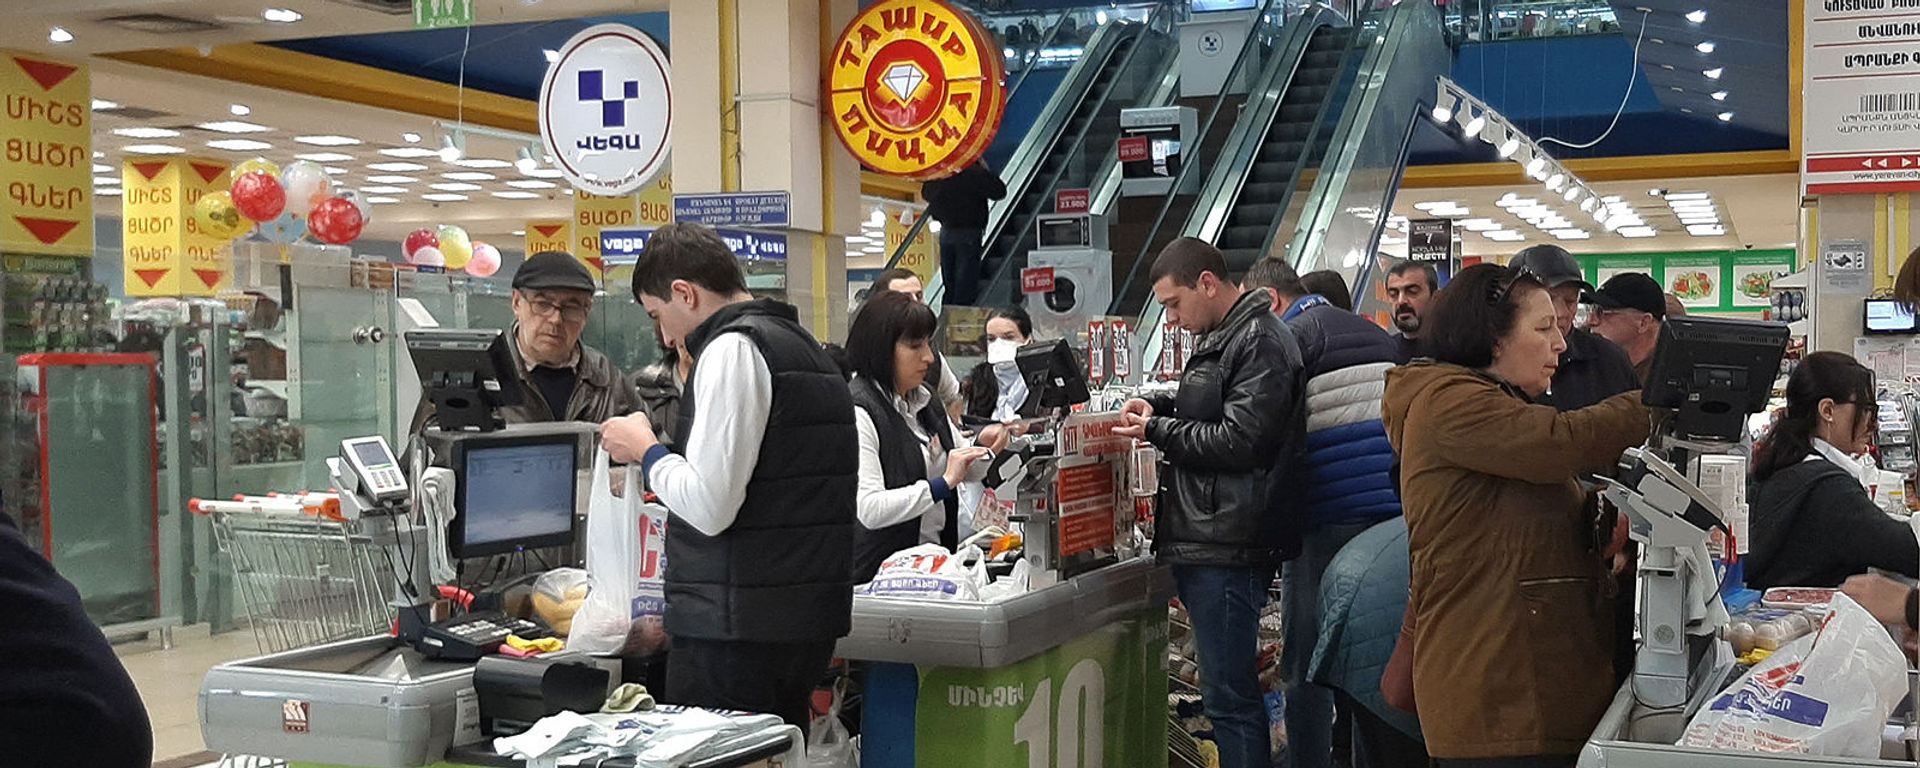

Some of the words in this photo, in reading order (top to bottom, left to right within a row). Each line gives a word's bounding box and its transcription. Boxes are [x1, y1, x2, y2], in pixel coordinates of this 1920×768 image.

[839, 6, 966, 68] ТАШИР
[1845, 53, 1909, 68] ԱՊՐԱՆՔԻ
[6, 94, 83, 127] ՄԻՇՏ
[842, 92, 972, 165] ПИЦЦА
[576, 134, 640, 150] ՎԵԳԱ
[6, 138, 85, 168] ՑԱԾՐ
[9, 181, 83, 209] ԳՆԵՐ
[128, 187, 172, 204] ՄԻՇՏ
[579, 210, 632, 226] ՑԱԾՐ
[640, 202, 672, 222] ՑԱԾ
[128, 217, 173, 234] ՑԱԾՐ
[130, 246, 172, 262] ԳՆԵՐ
[1014, 658, 1105, 768] 10
